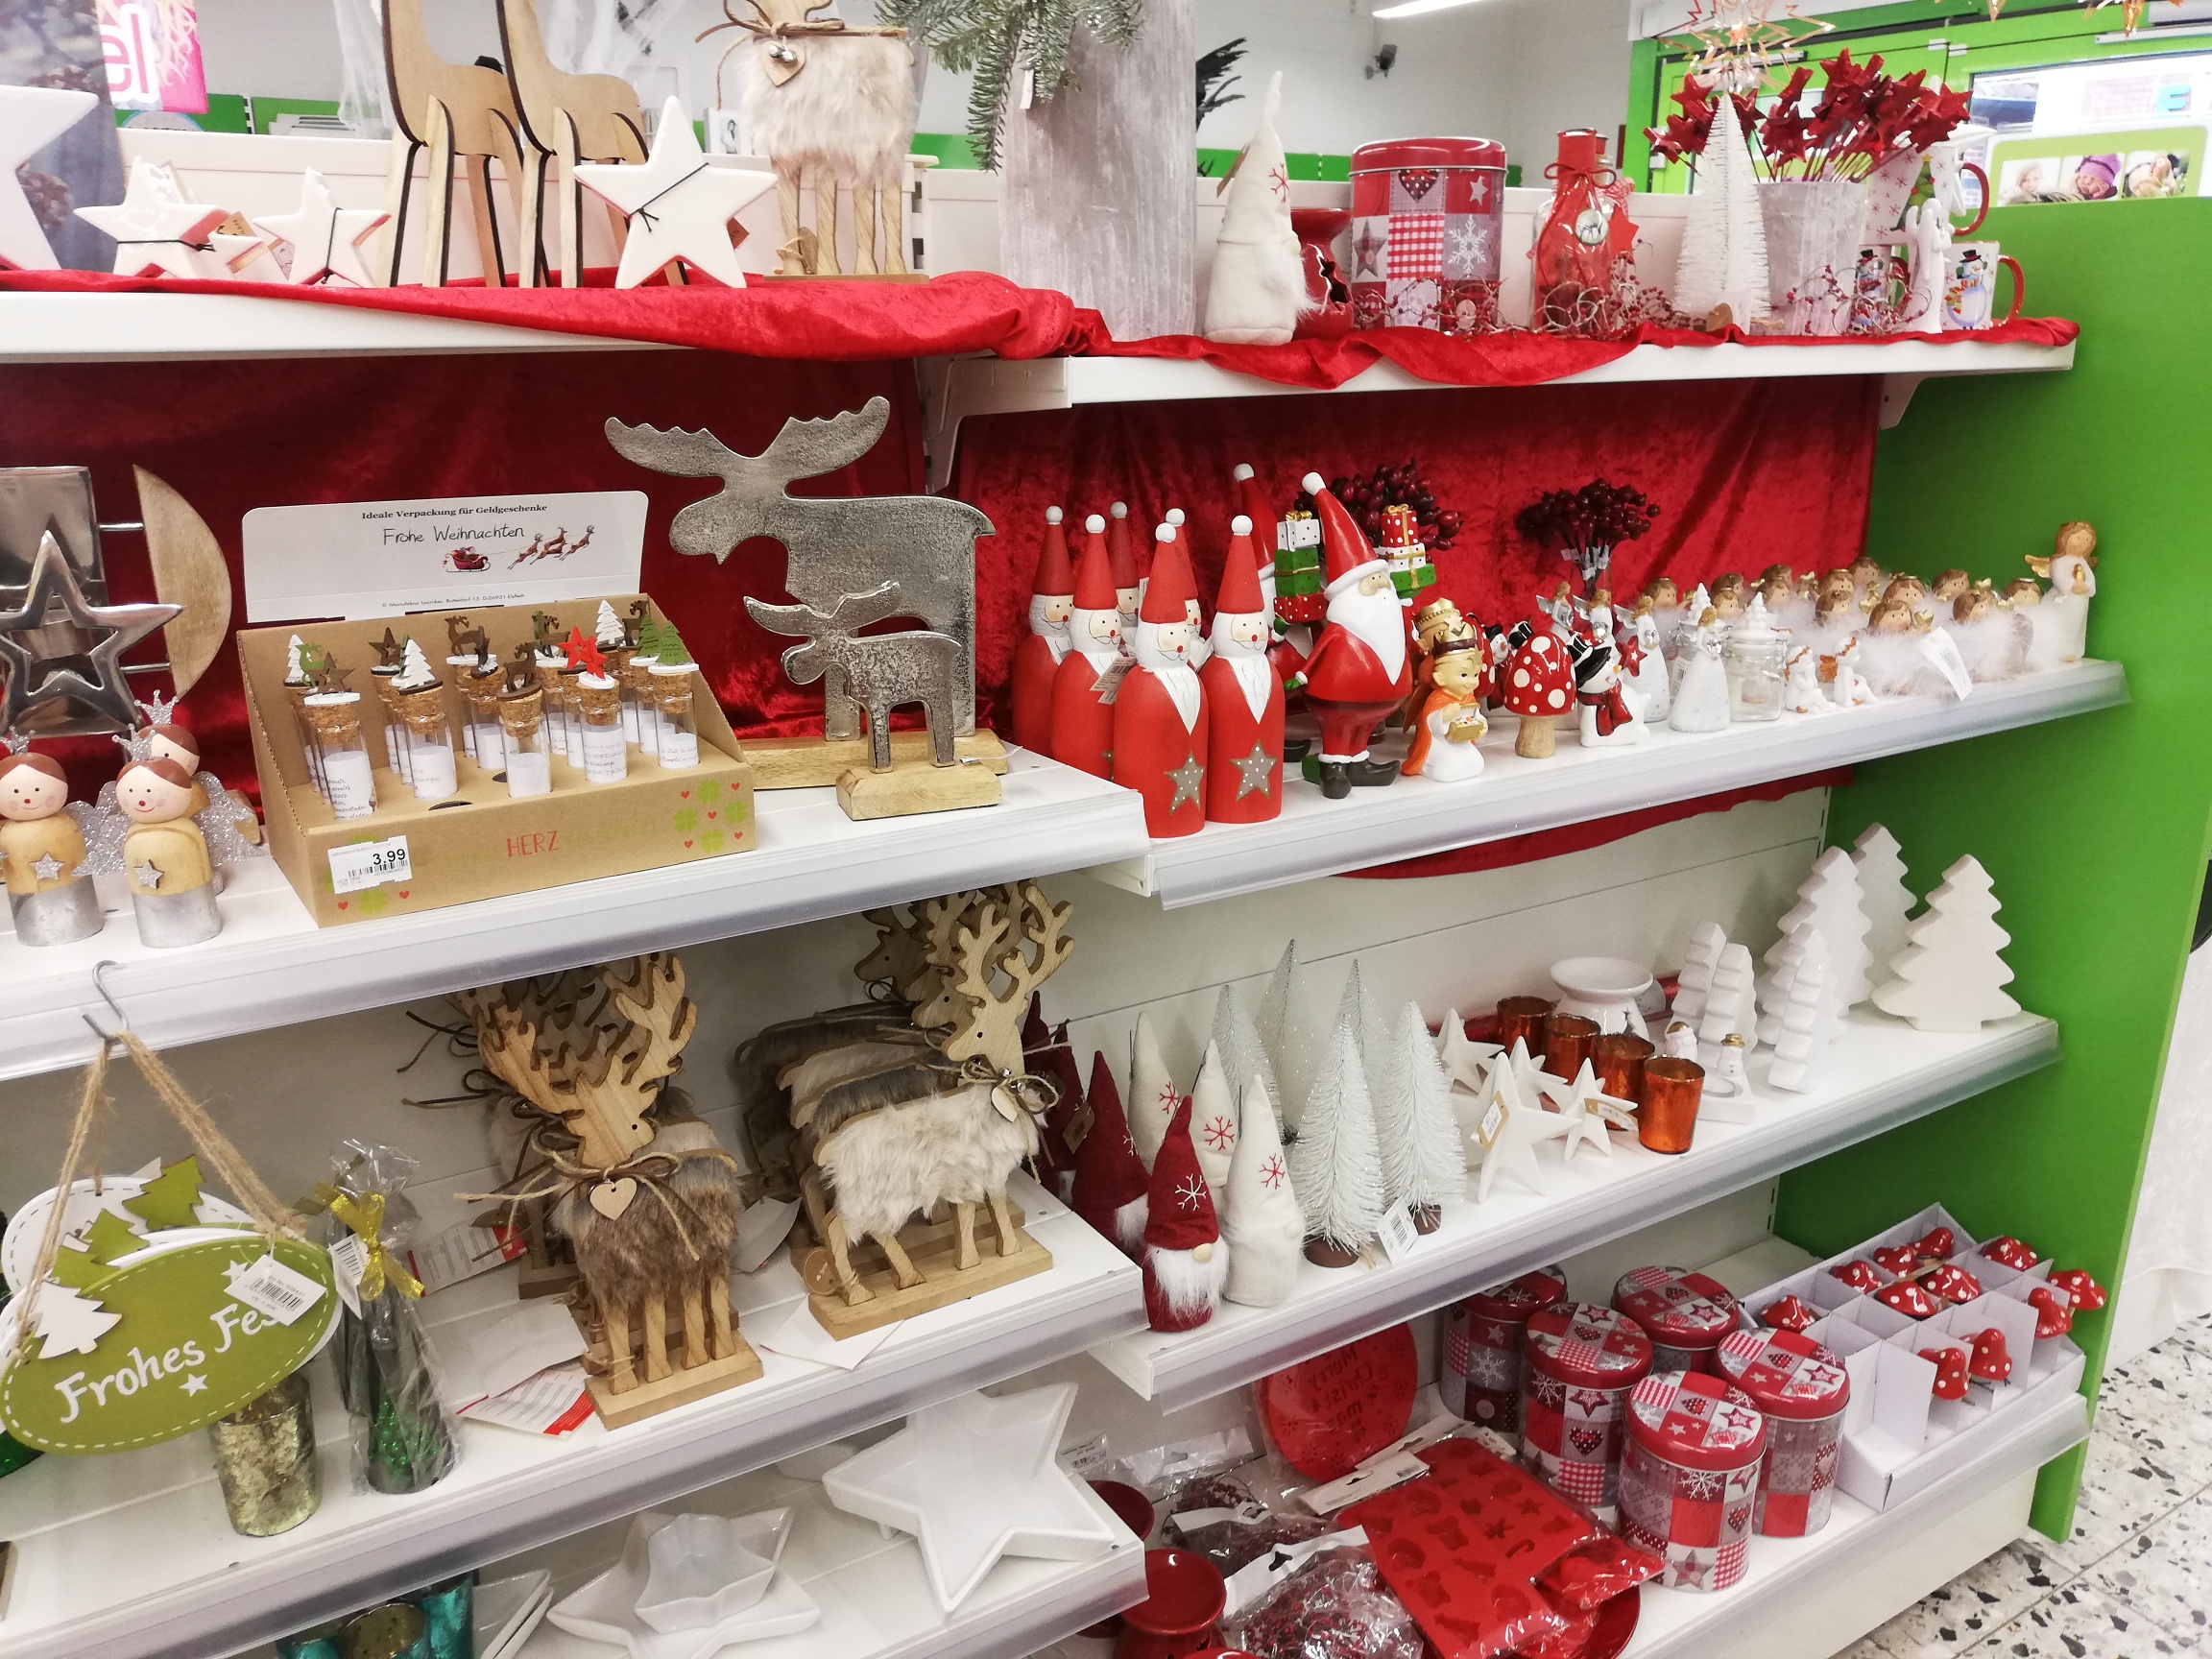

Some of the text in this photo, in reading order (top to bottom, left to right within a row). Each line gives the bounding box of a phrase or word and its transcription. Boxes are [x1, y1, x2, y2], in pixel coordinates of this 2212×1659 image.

[361, 511, 394, 519] Ideale
[396, 509, 456, 518] Verpackung
[475, 504, 548, 515] Geldgeschenke
[382, 522, 525, 545] Frohe Weihnachten
[505, 830, 560, 858] HERZ
[372, 848, 406, 865] 3.99
[53, 1303, 280, 1424] Frohes Fes
